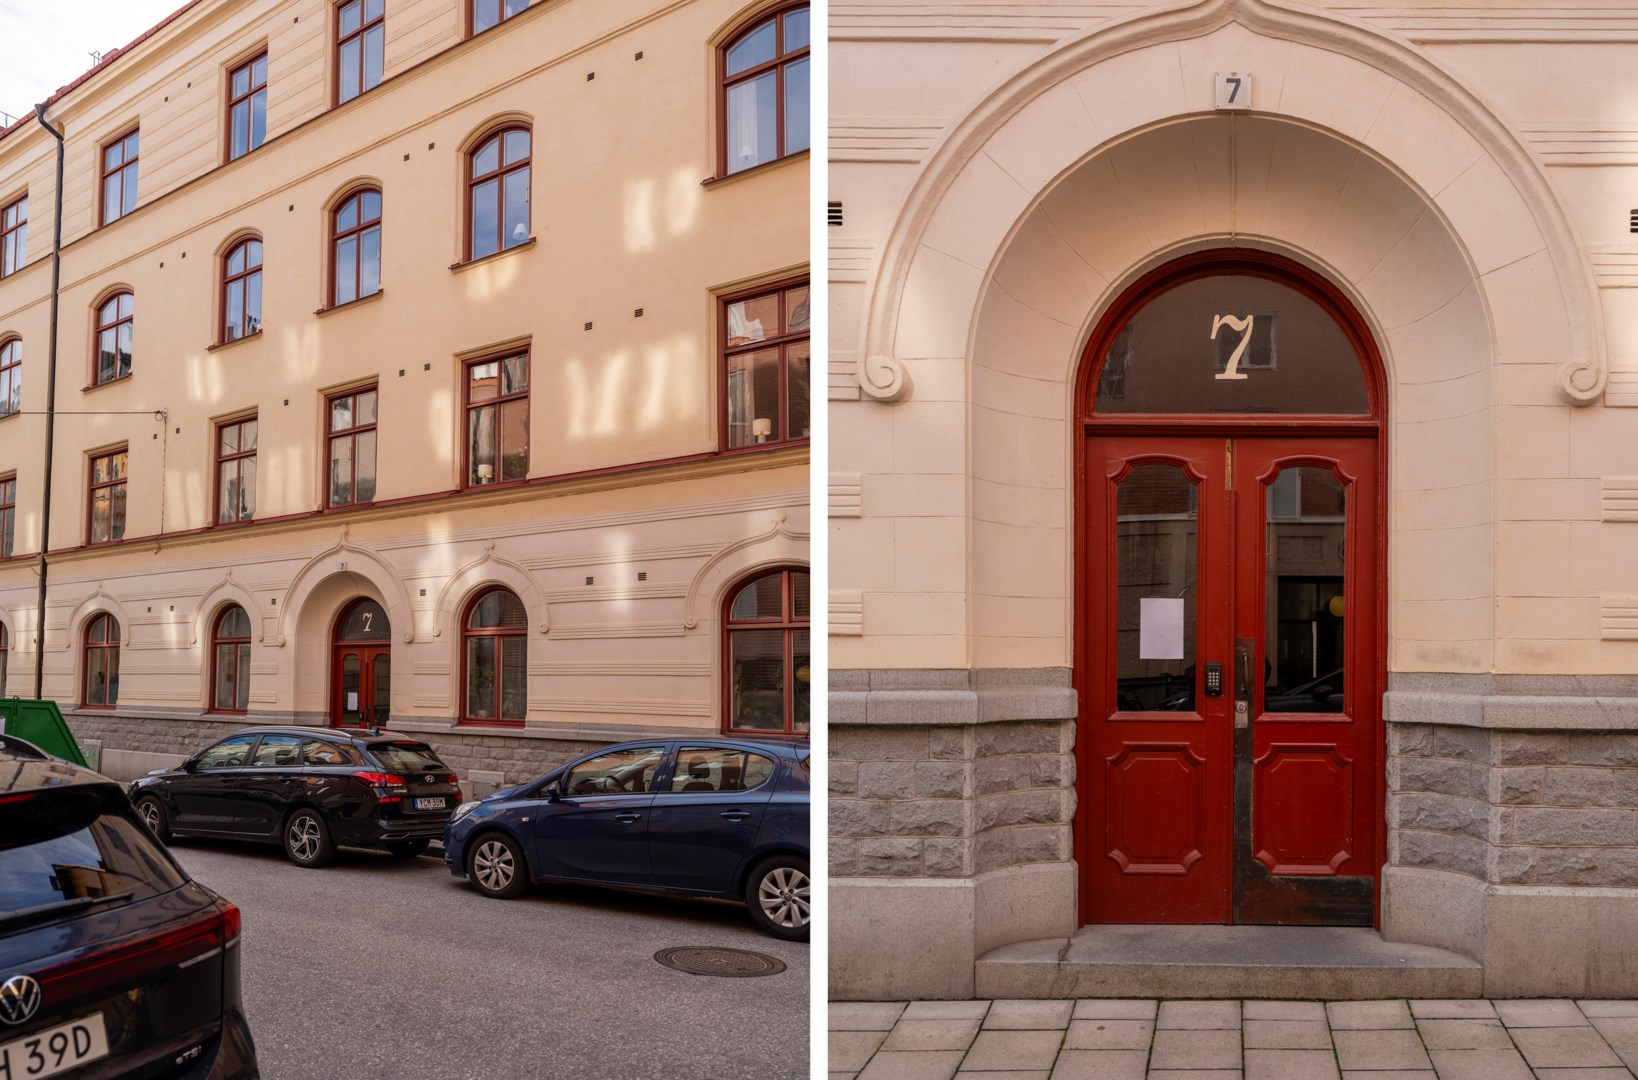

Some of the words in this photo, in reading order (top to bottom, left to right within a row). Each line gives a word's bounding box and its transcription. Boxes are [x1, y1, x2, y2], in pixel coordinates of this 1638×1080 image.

[1226, 78, 1241, 103] 7
[1210, 314, 1253, 380] 7
[362, 612, 373, 632] 7
[25, 1025, 91, 1075] 39D
